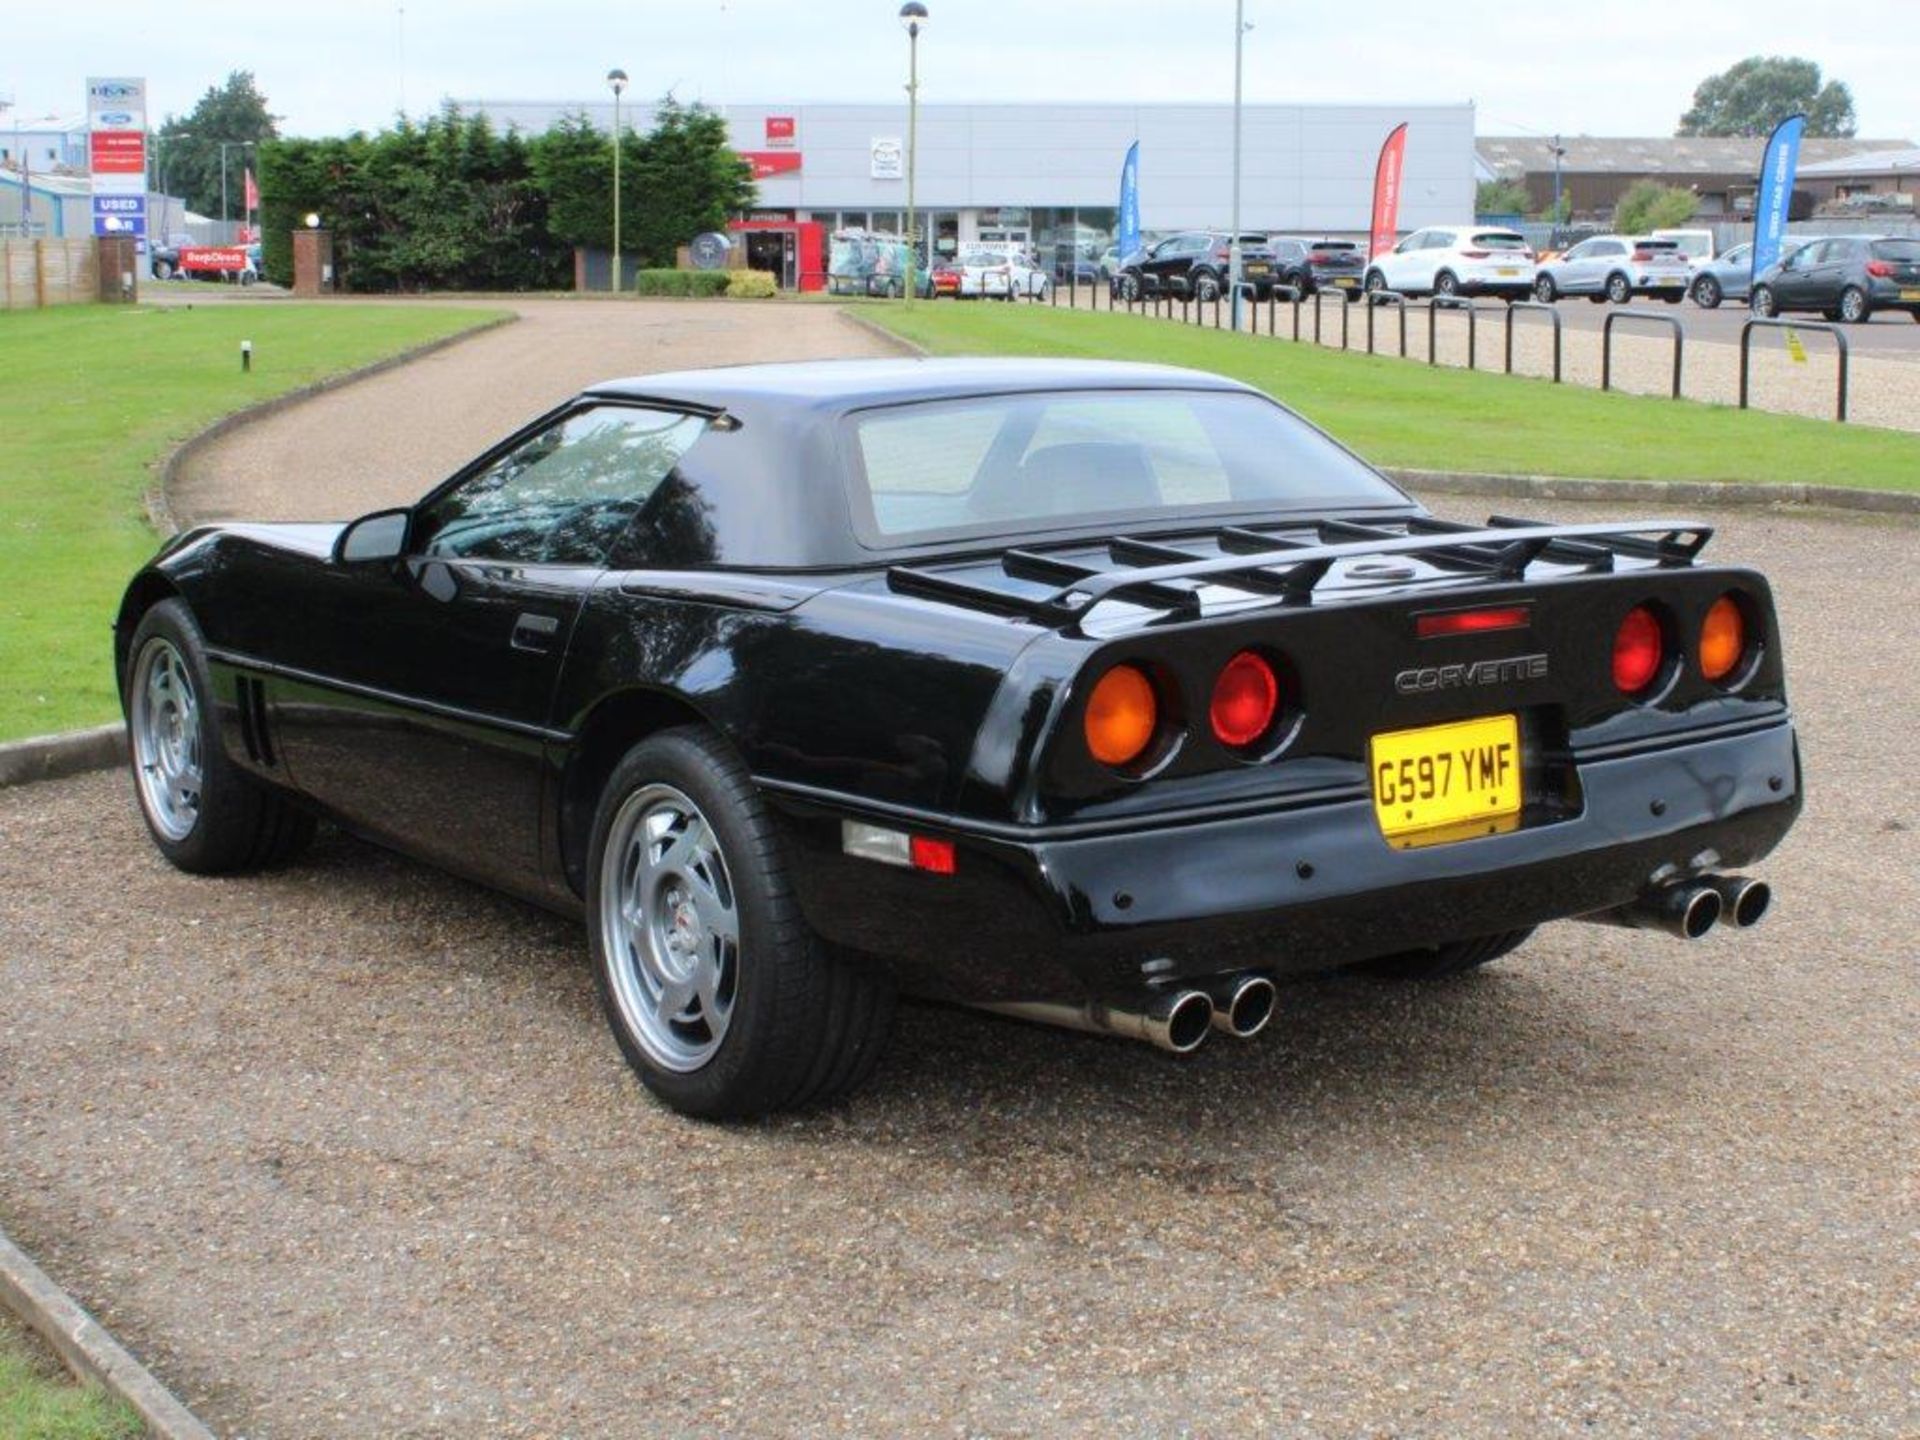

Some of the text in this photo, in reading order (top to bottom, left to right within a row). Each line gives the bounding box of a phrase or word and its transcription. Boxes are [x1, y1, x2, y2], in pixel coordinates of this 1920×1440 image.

[101, 200, 138, 210] USED
[1395, 653, 1548, 694] CORVETTE
[1378, 743, 1511, 806] G597 YMF
